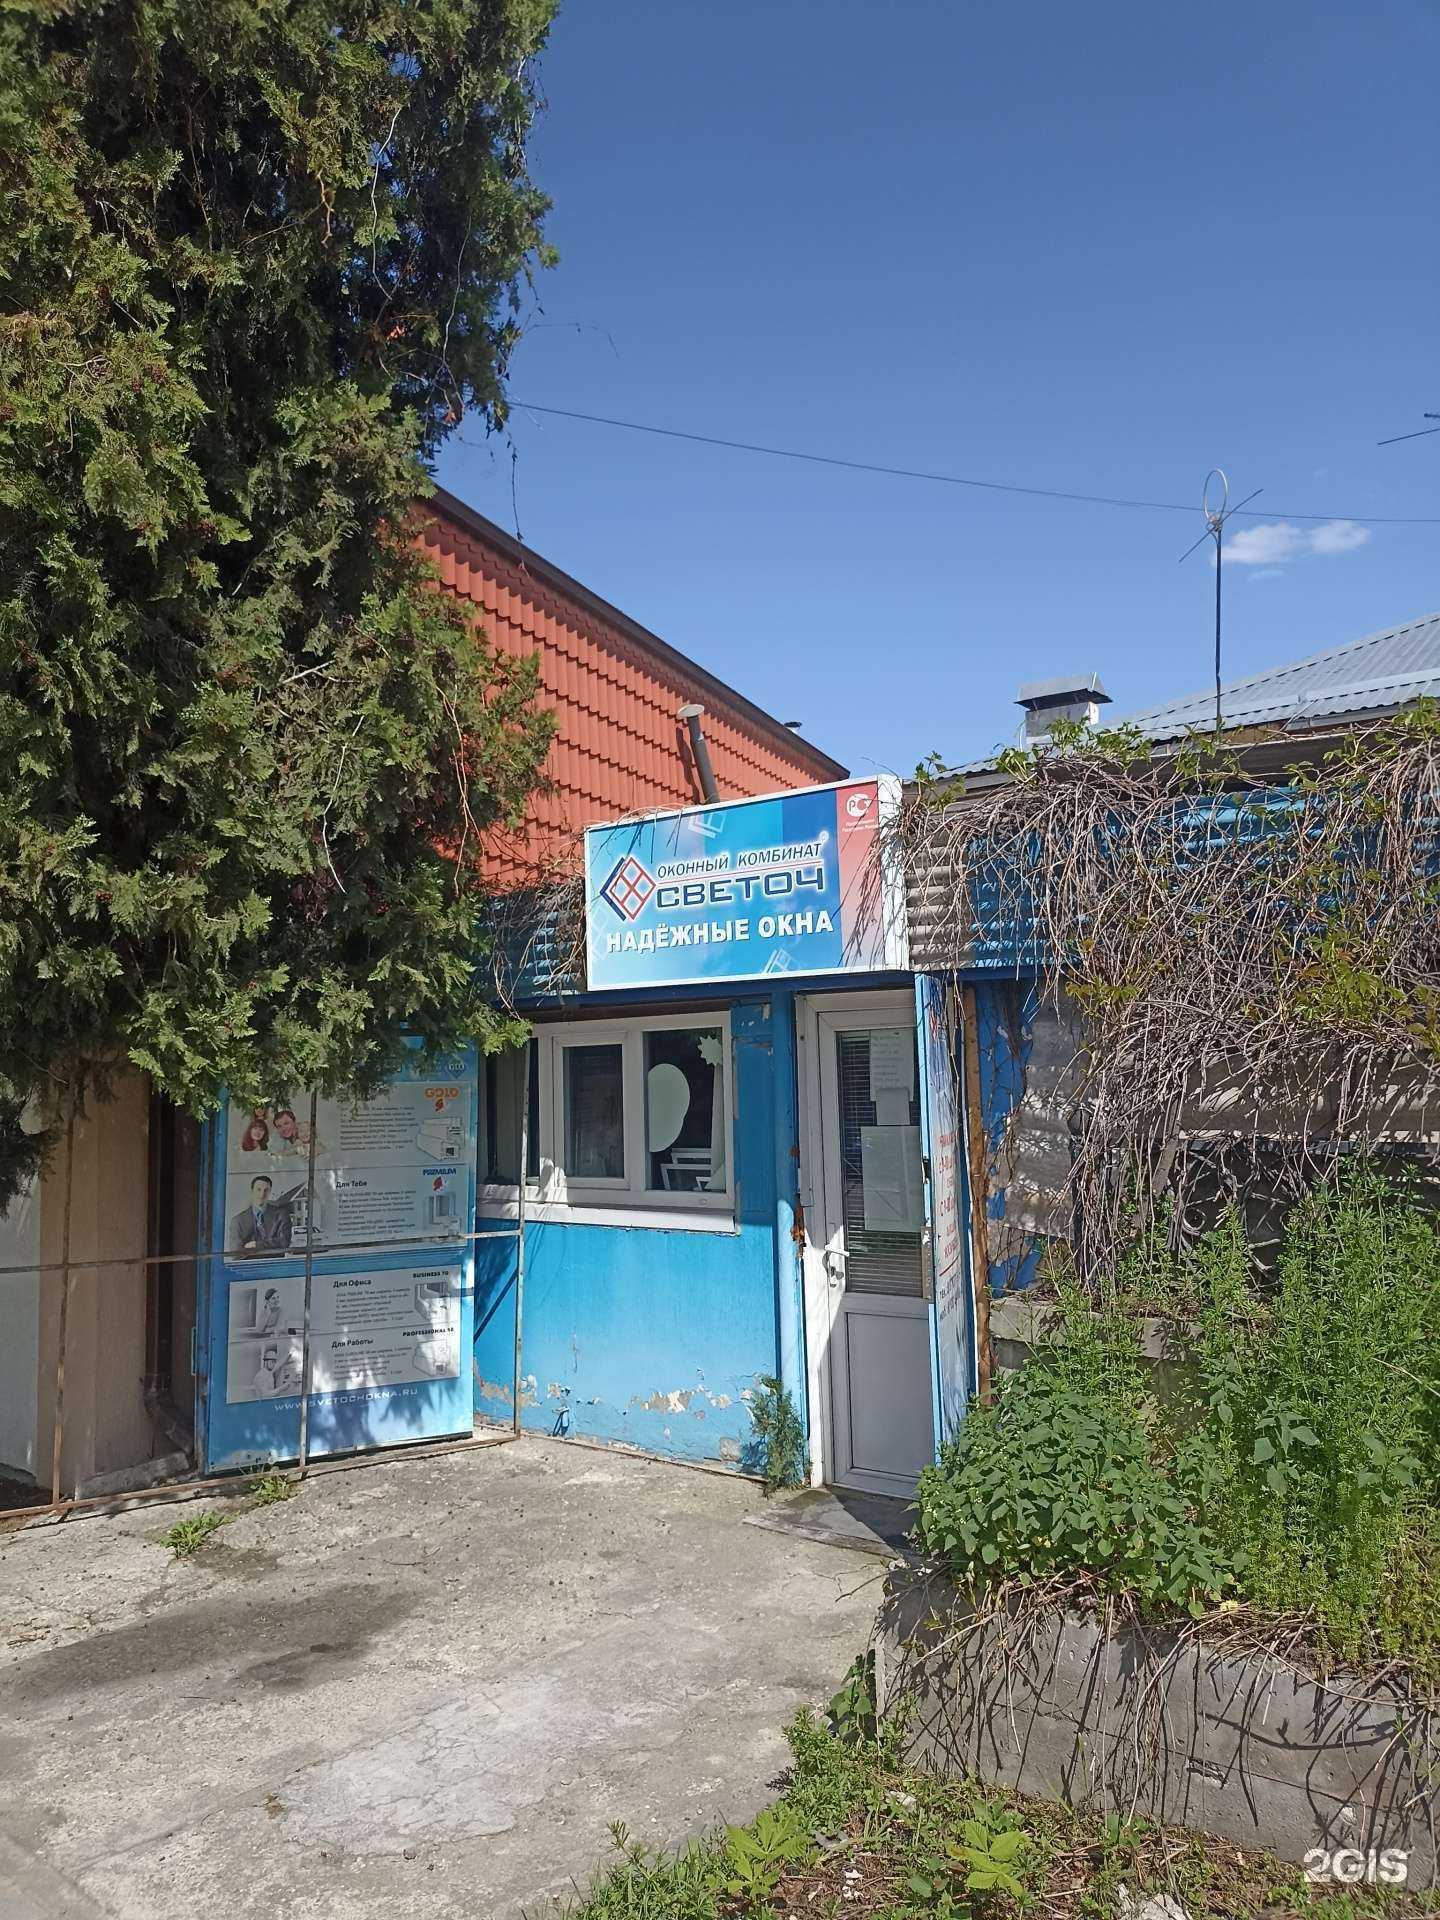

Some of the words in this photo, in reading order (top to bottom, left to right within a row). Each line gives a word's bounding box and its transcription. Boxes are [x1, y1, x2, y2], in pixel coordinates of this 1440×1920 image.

[657, 853, 729, 879] ОКОННЫЙ
[738, 842, 823, 867] КОМБИНАТ
[656, 867, 825, 908] СВЕТОЧ
[606, 918, 750, 954] НАДЁЖНЫЕ
[758, 910, 834, 936] ОКНА
[335, 1181, 350, 1189] Для
[333, 1280, 348, 1289] Для
[348, 1278, 372, 1288] Офиса
[331, 1340, 346, 1349] Для
[346, 1338, 374, 1348] Работы
